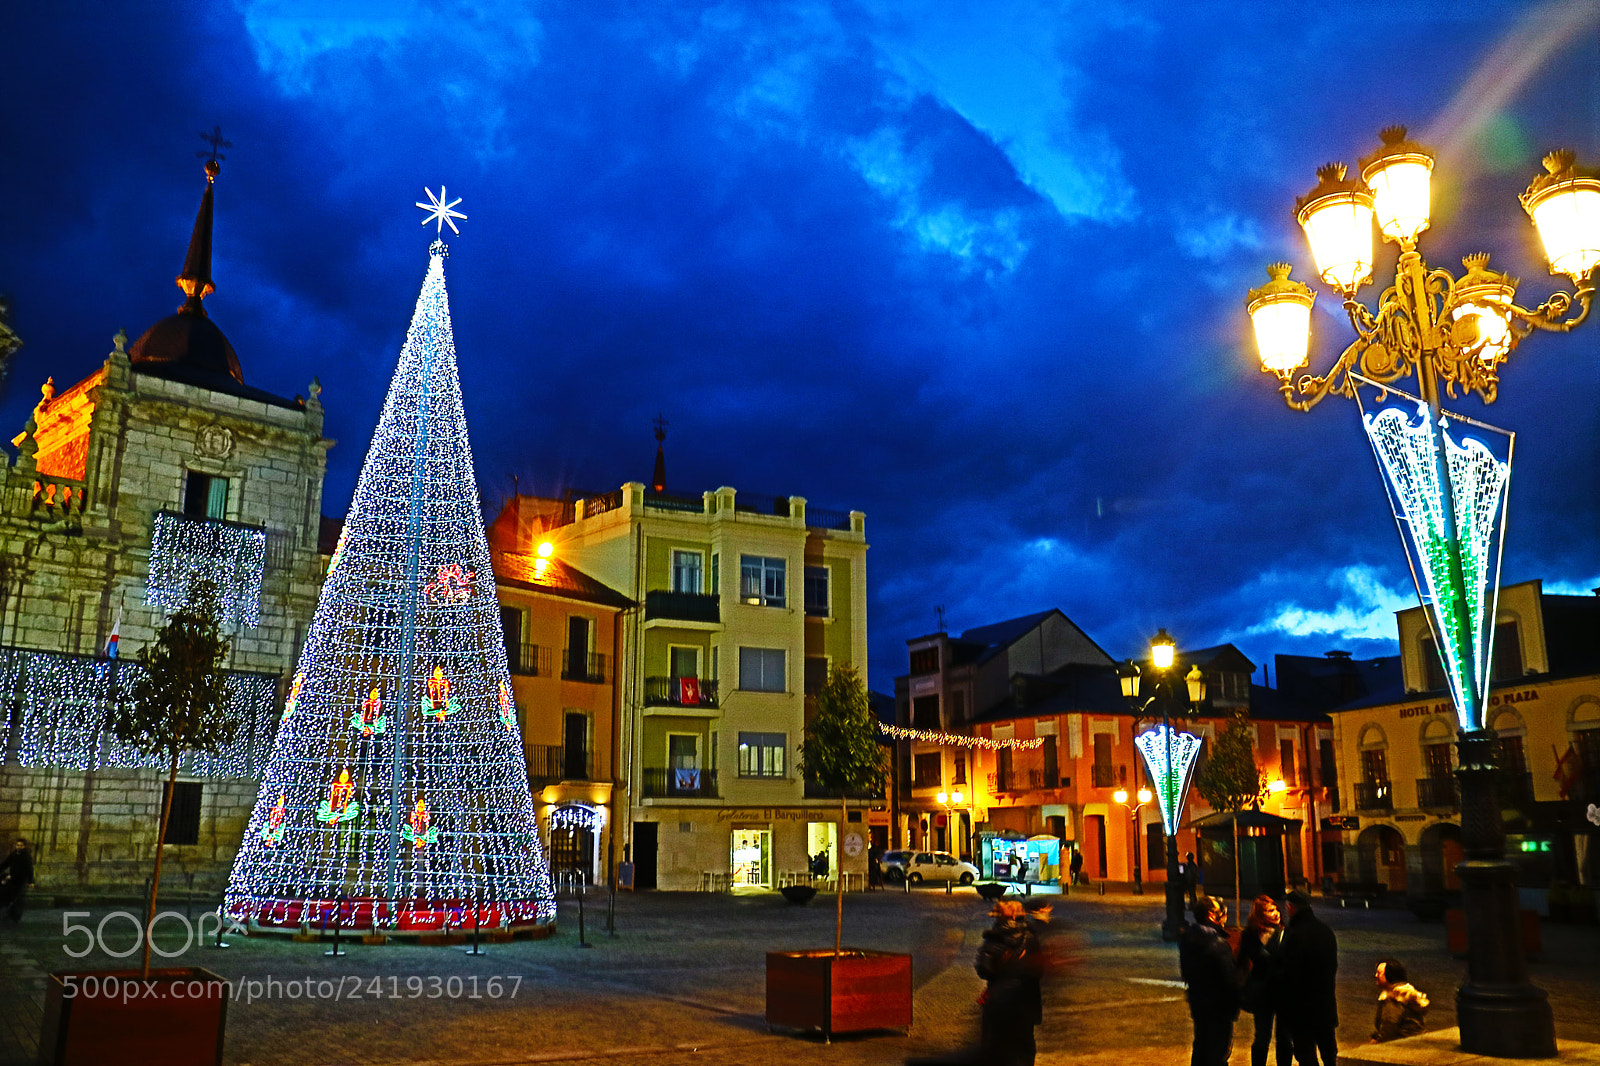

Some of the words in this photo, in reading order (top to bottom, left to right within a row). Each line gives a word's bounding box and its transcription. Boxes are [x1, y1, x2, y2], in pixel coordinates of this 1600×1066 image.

[1399, 705, 1431, 719] HOTEL
[1504, 689, 1539, 704] PLAZA
[764, 809, 772, 820] El
[775, 809, 824, 823] Barquillero
